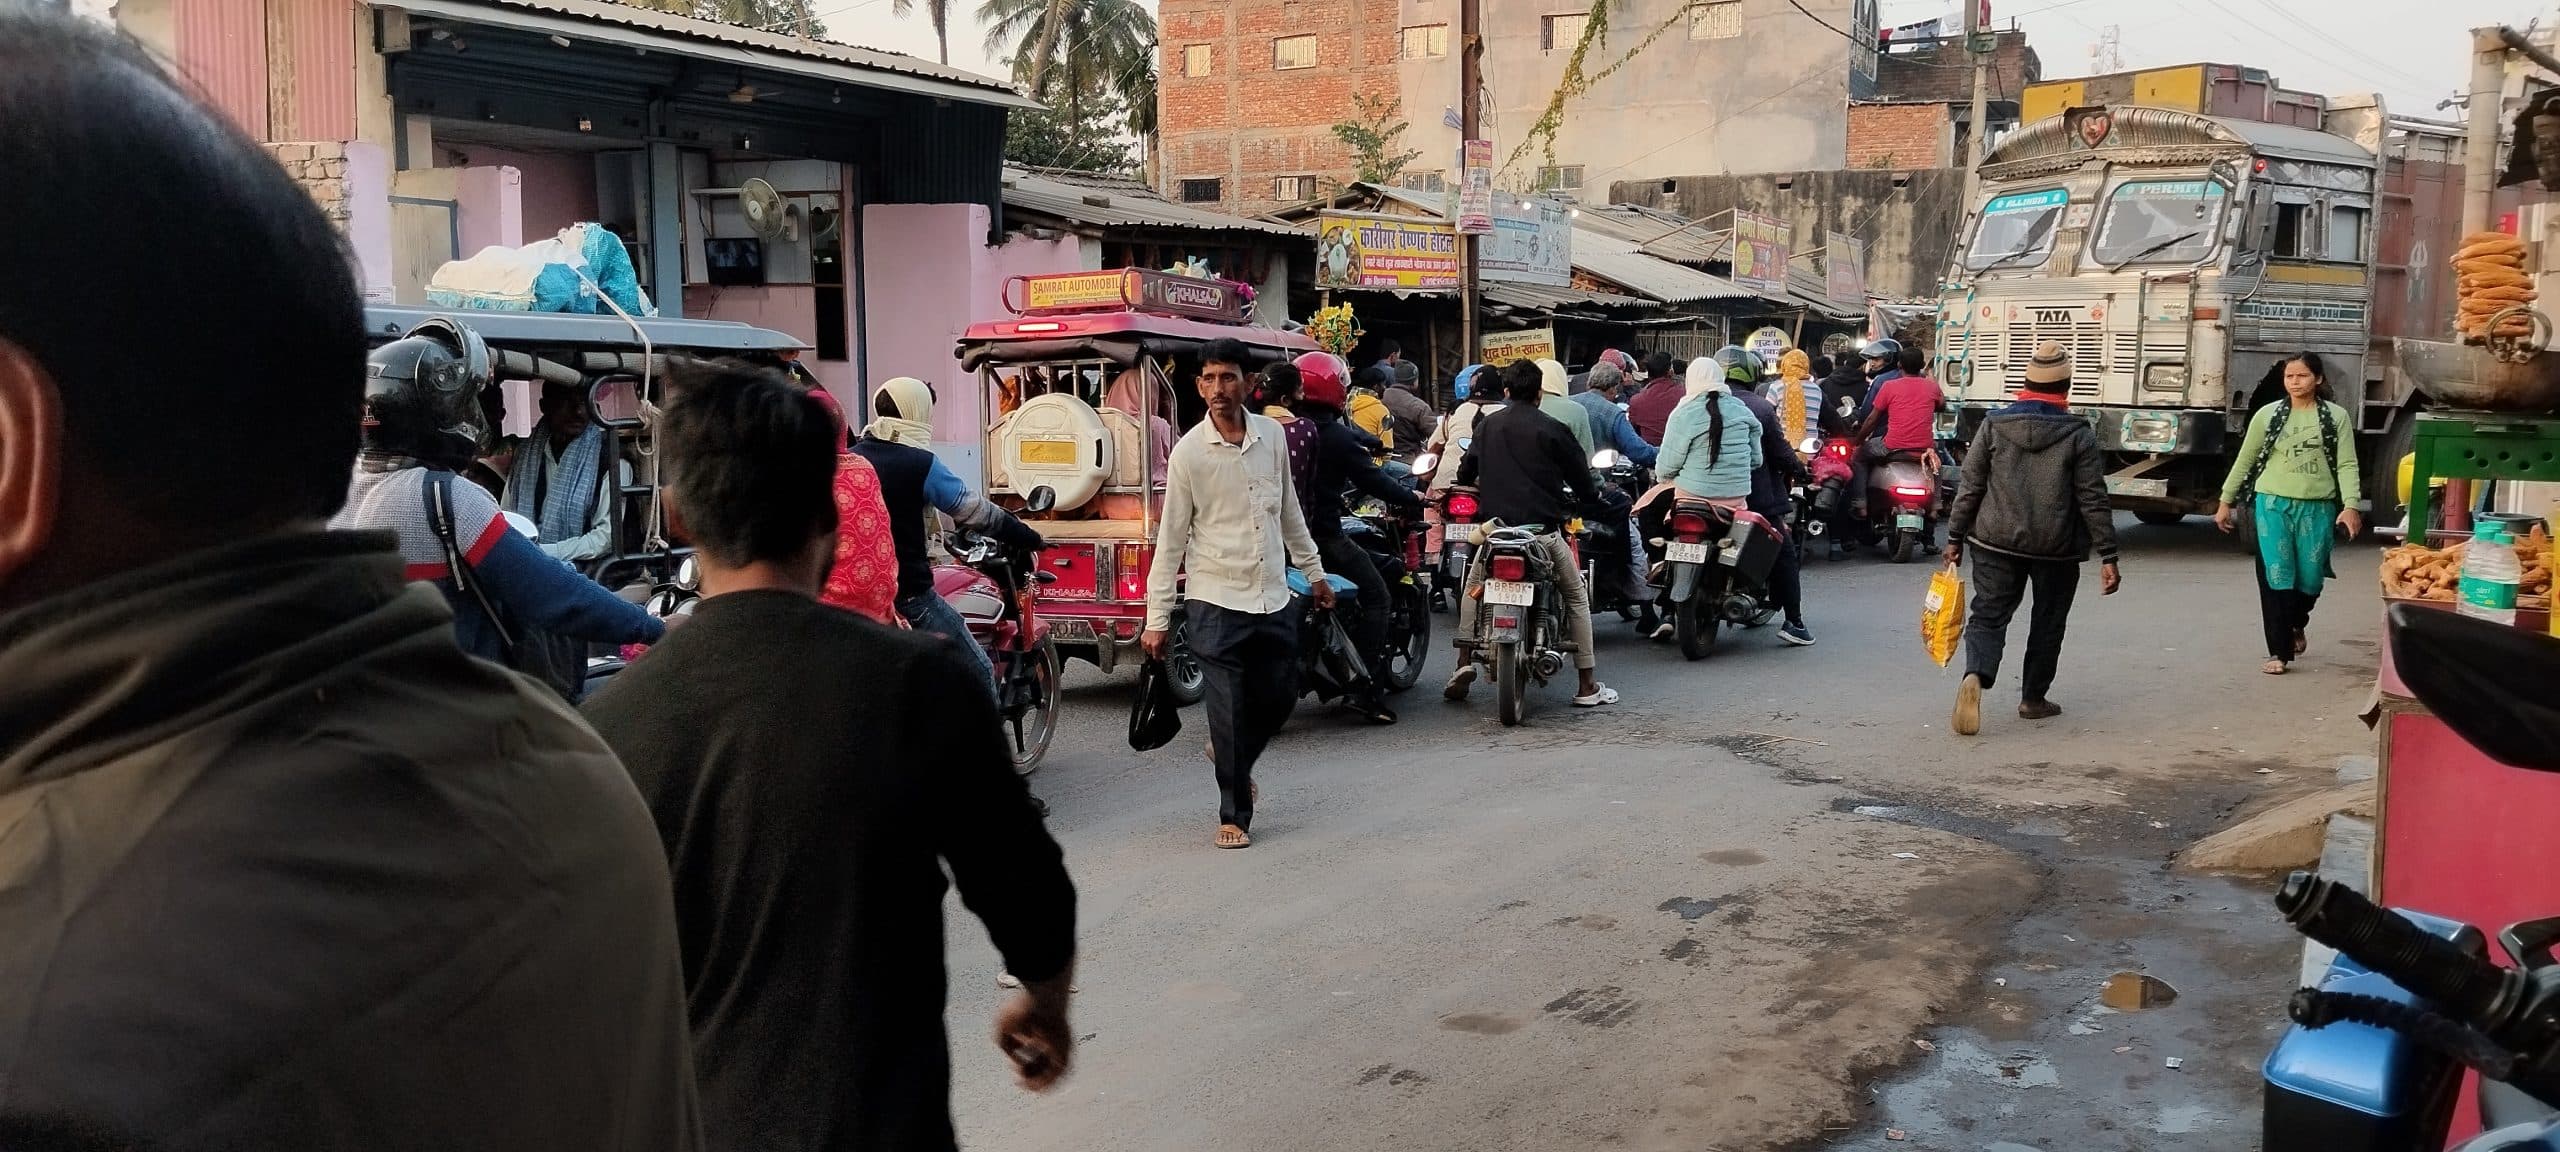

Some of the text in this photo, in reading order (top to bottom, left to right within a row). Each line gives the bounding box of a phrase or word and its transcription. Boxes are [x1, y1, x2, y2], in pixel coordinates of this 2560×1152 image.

[2140, 184, 2201, 194] PERMIT
[1360, 222, 1396, 249] कारीगर
[1430, 226, 1455, 252] होटल
[1033, 277, 1129, 294] SAMRAT AUTOMOBILS
[1176, 286, 1211, 304] KHALSA
[2035, 310, 2072, 322] TATA
[1501, 344, 1513, 356] घी
[1521, 342, 1550, 356] खाजा
